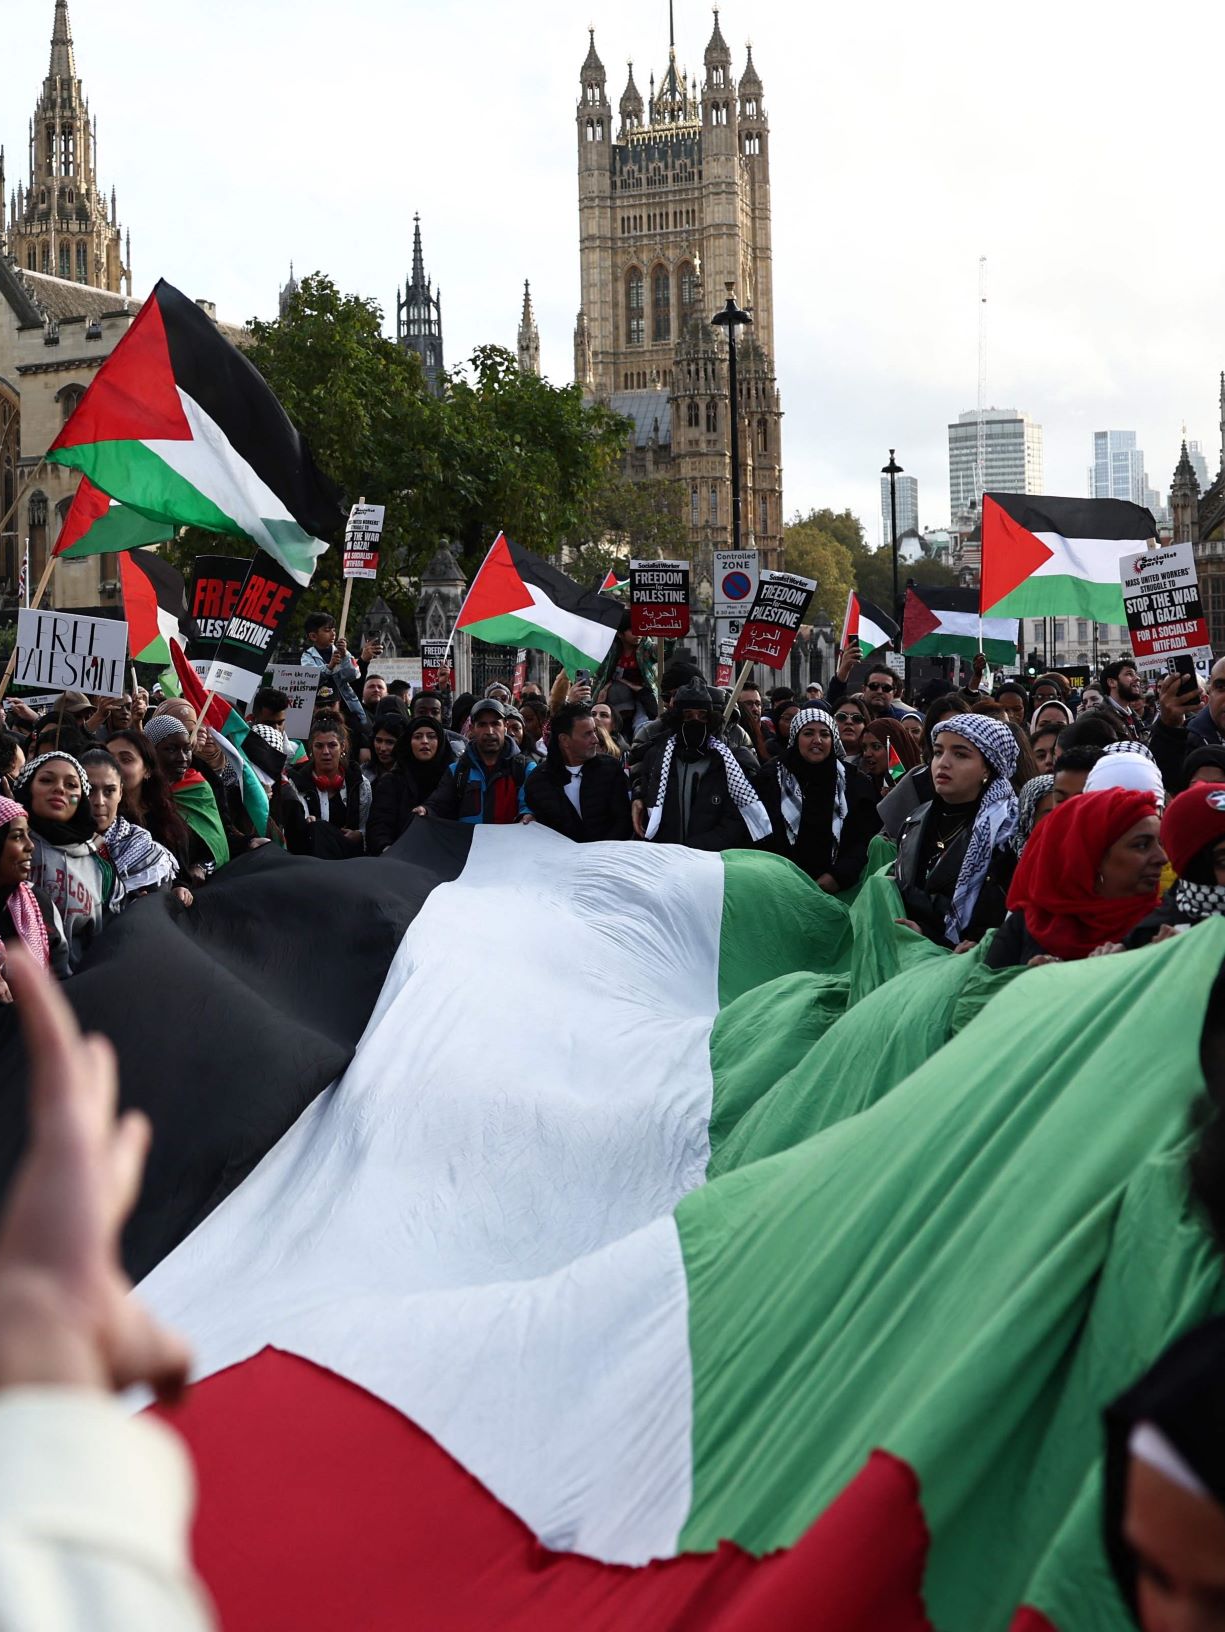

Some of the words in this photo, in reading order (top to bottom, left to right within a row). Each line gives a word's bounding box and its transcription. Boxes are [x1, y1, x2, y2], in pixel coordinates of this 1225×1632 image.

[353, 532, 364, 541] THE
[364, 532, 380, 542] WAR
[353, 541, 370, 551] GAZA!
[716, 552, 756, 560] Controlled
[1141, 552, 1177, 565] Socialist
[722, 561, 750, 570] ZONE
[635, 572, 683, 585] FREEDOM
[788, 577, 809, 588] Worker
[1125, 578, 1141, 588] MASS
[1140, 573, 1160, 585] UNITED
[1140, 581, 1168, 593] STRUGGLE
[1167, 579, 1176, 588] TO
[192, 578, 242, 618] FRE
[236, 574, 294, 629] FREE
[633, 590, 686, 603] PALESTINE
[761, 584, 807, 606] FREEDOM
[1126, 597, 1149, 614] STOP
[1150, 592, 1170, 608] THE
[1171, 586, 1199, 605] WAR
[772, 599, 781, 608] for
[643, 608, 677, 621] الحرية
[751, 606, 801, 628] PALESTINE
[1140, 611, 1155, 626] ON
[1156, 605, 1187, 624] GAZA!
[638, 618, 682, 631] لفلسطين
[1136, 630, 1151, 642] FOR
[1152, 628, 1158, 639] A
[1158, 620, 1199, 637] SOCIALIST
[36, 615, 110, 656] FREE
[226, 617, 275, 649] PALESTINE
[1152, 636, 1188, 652] INTIFADA
[14, 646, 124, 695] PALESTINE
[1069, 677, 1084, 687] THE
